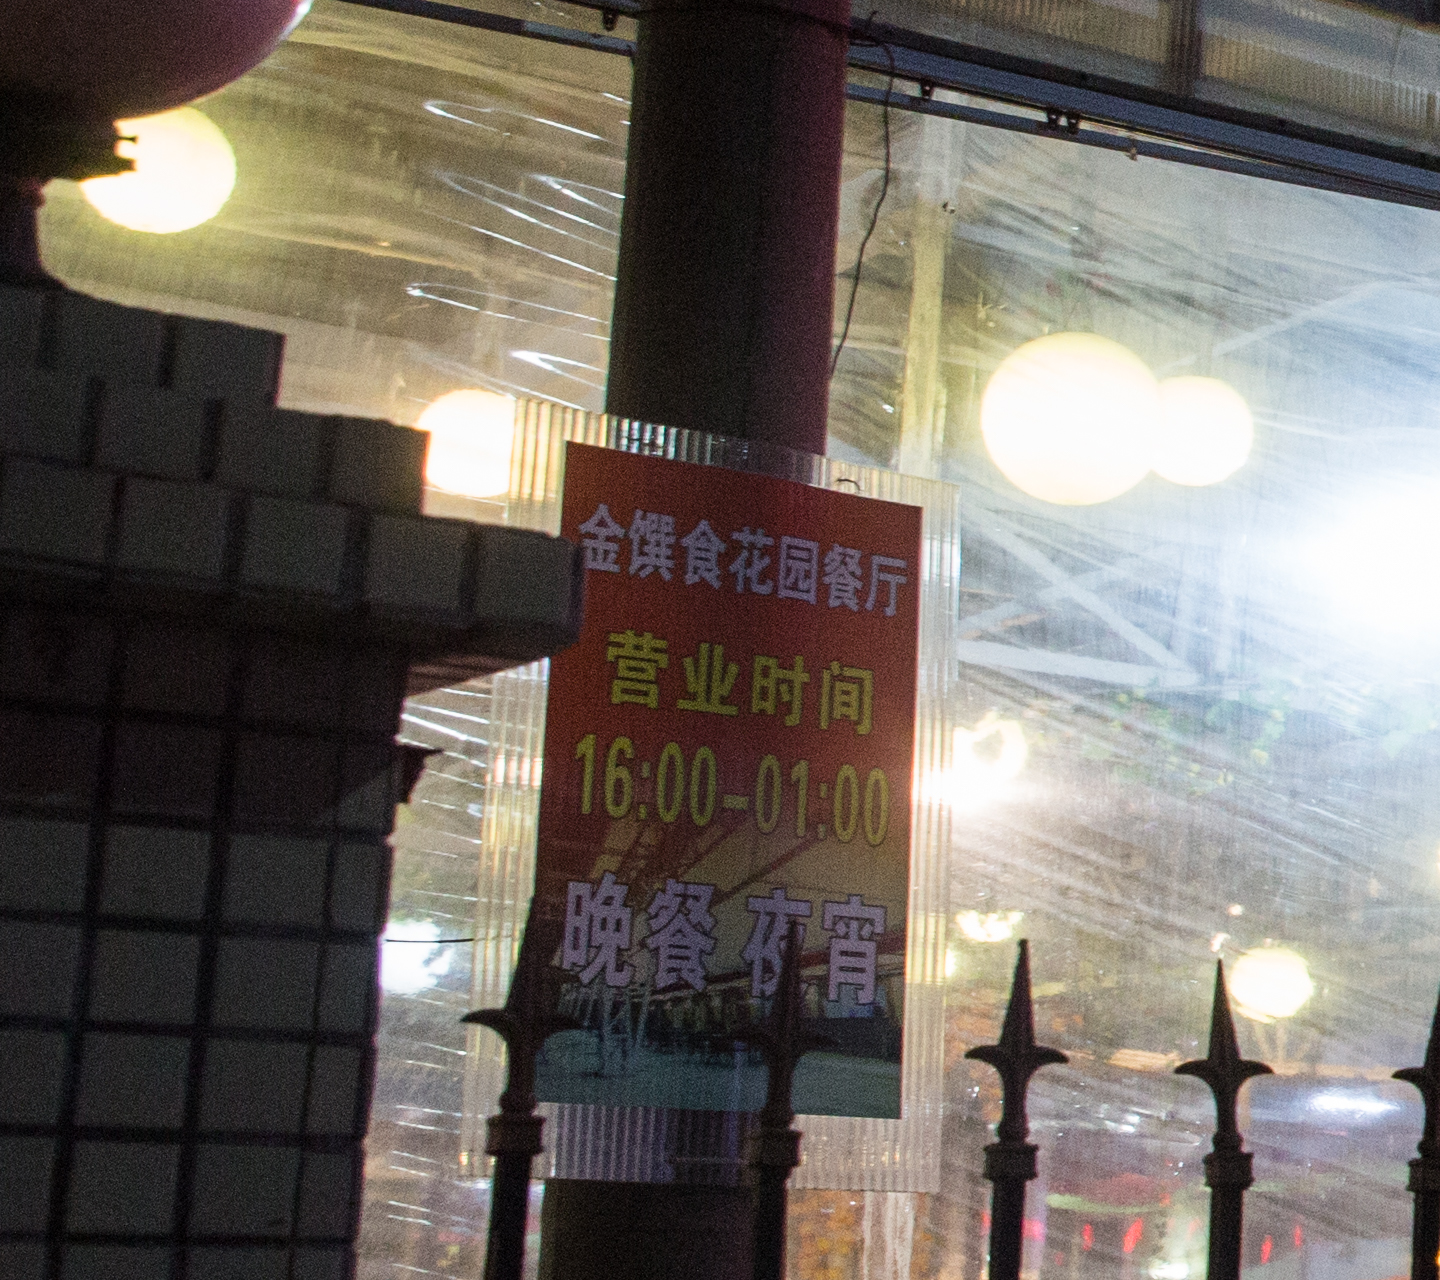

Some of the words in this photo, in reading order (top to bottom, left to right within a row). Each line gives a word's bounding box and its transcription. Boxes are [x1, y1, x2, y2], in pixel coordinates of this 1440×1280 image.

[578, 503, 908, 617] 金馔食花园餐厅
[606, 629, 875, 736] 营业时间
[575, 733, 889, 847] 16:00-01:00
[561, 871, 717, 993] 晚餐
